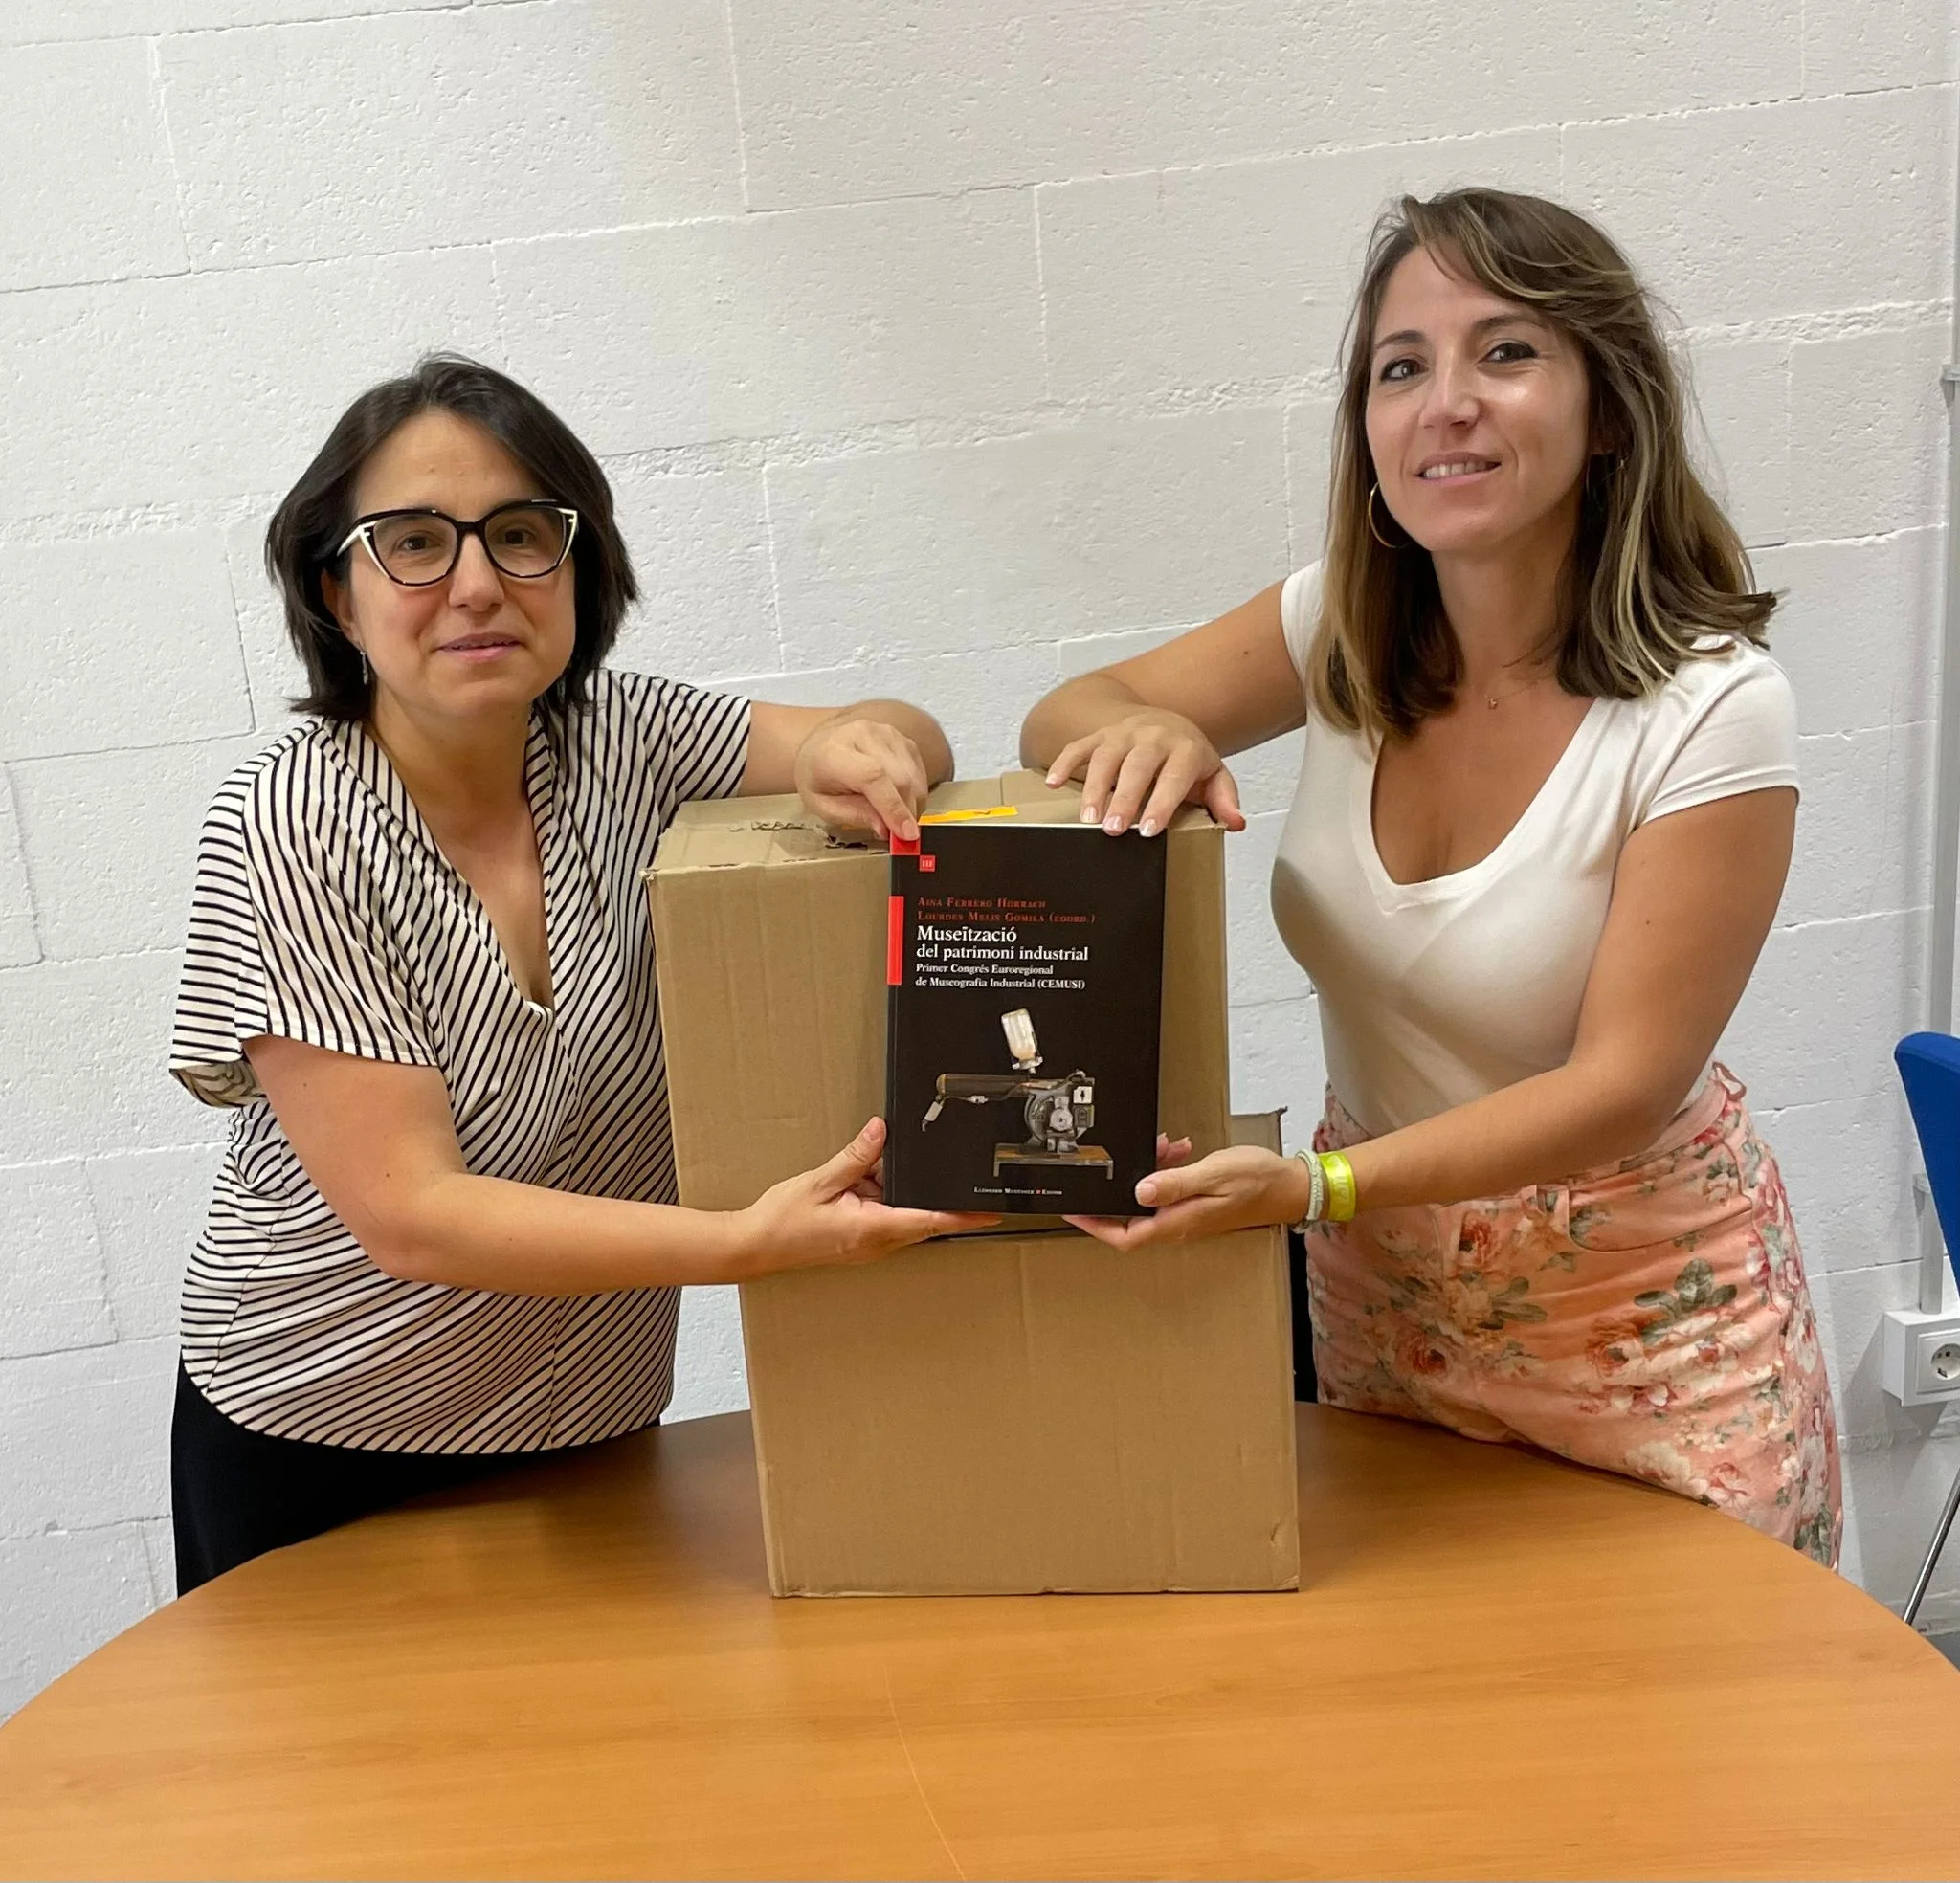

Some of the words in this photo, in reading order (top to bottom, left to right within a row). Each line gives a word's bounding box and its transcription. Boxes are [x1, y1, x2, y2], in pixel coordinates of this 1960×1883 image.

[917, 925, 1017, 942] Museïtzació
[916, 943, 939, 958] del
[943, 945, 1014, 962] patrimoni
[1019, 945, 1089, 961] industrial
[916, 963, 948, 973] Primer
[950, 964, 990, 975] Congrés
[991, 964, 1054, 976] Euroregional
[915, 976, 927, 986] de
[929, 977, 988, 989] Museografia
[990, 978, 1036, 988] Industrial
[1037, 979, 1086, 990] (CEMUSI)
